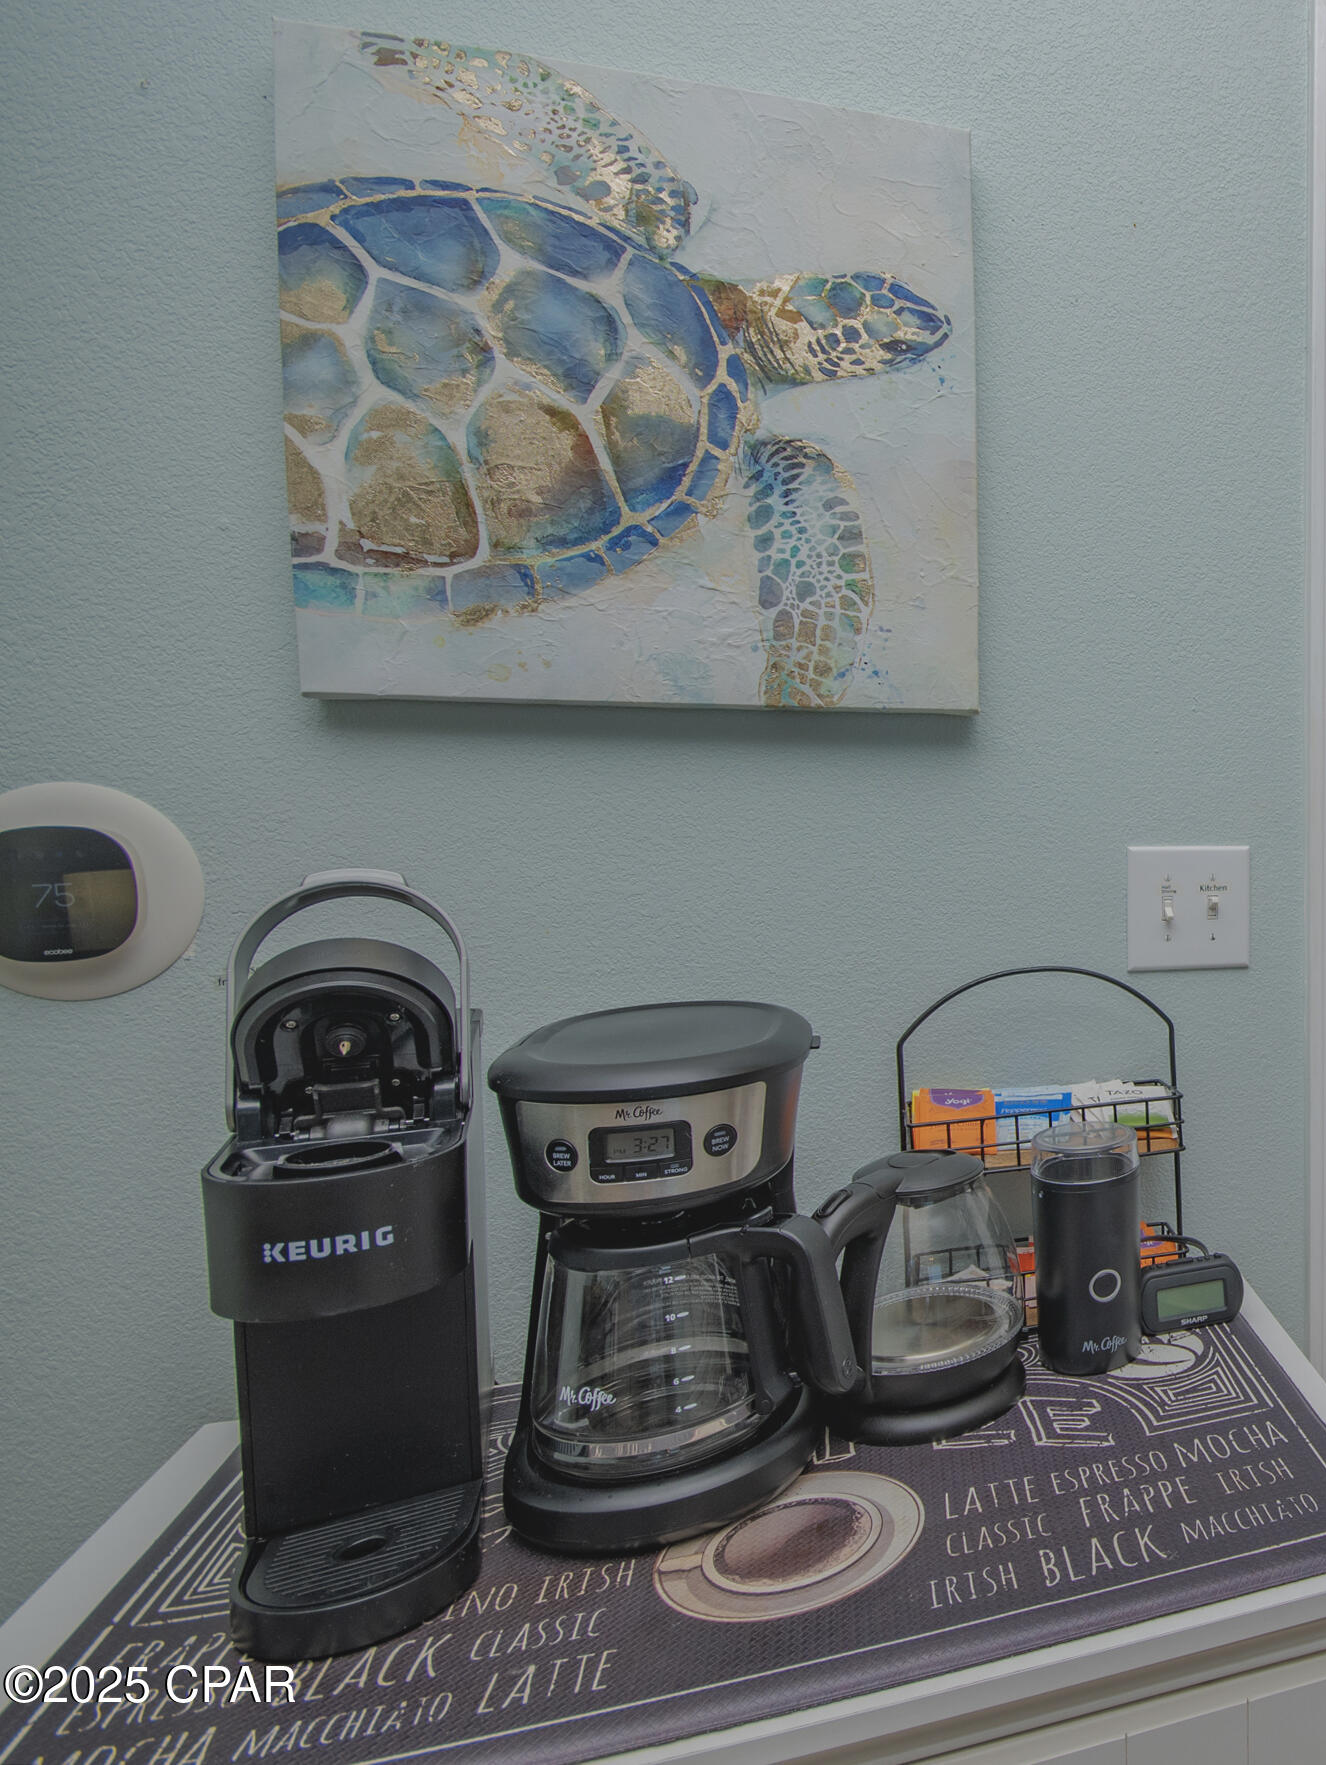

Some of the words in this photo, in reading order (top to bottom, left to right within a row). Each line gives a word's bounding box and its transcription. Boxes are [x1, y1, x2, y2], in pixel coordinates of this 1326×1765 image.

[1199, 884, 1228, 893] Kitchen
[32, 883, 76, 909] 75
[1107, 1089, 1143, 1097] TAZO
[615, 1107, 632, 1120] Mr.
[632, 1105, 663, 1119] Coffee
[633, 1135, 670, 1154] 3:27
[711, 1135, 730, 1145] BREW
[711, 1142, 729, 1151] NOW
[552, 1152, 571, 1160] BREW
[553, 1159, 572, 1168] LATER
[664, 1165, 689, 1175] STRONG
[262, 1225, 395, 1264] KEURIG
[663, 1276, 675, 1285] 12
[664, 1313, 676, 1322] 10
[1181, 1315, 1208, 1326] SHARP
[1082, 1337, 1101, 1353] Mr.
[1101, 1335, 1128, 1352] Coffee
[673, 1378, 680, 1386] 6
[559, 1386, 578, 1405] Mr.
[578, 1387, 617, 1411] Coffee
[675, 1405, 683, 1414] 4
[944, 1476, 1040, 1519] LATTE
[1051, 1451, 1168, 1496] ESPRESSO
[1174, 1420, 1289, 1469] MOCHA
[946, 1511, 1052, 1558] CLASSIC
[1080, 1476, 1198, 1528] FRAPPE
[1216, 1457, 1295, 1496] IRISH
[929, 1562, 1019, 1610] IRISH
[1039, 1525, 1168, 1588] BLACK
[1180, 1493, 1319, 1545] MACCHIATO
[534, 1559, 635, 1605] IRISH
[272, 1633, 453, 1707] BLACK
[470, 1608, 607, 1660] CLASSIC
[231, 1692, 453, 1762] MACCHIATO
[476, 1650, 617, 1714] LATTE
